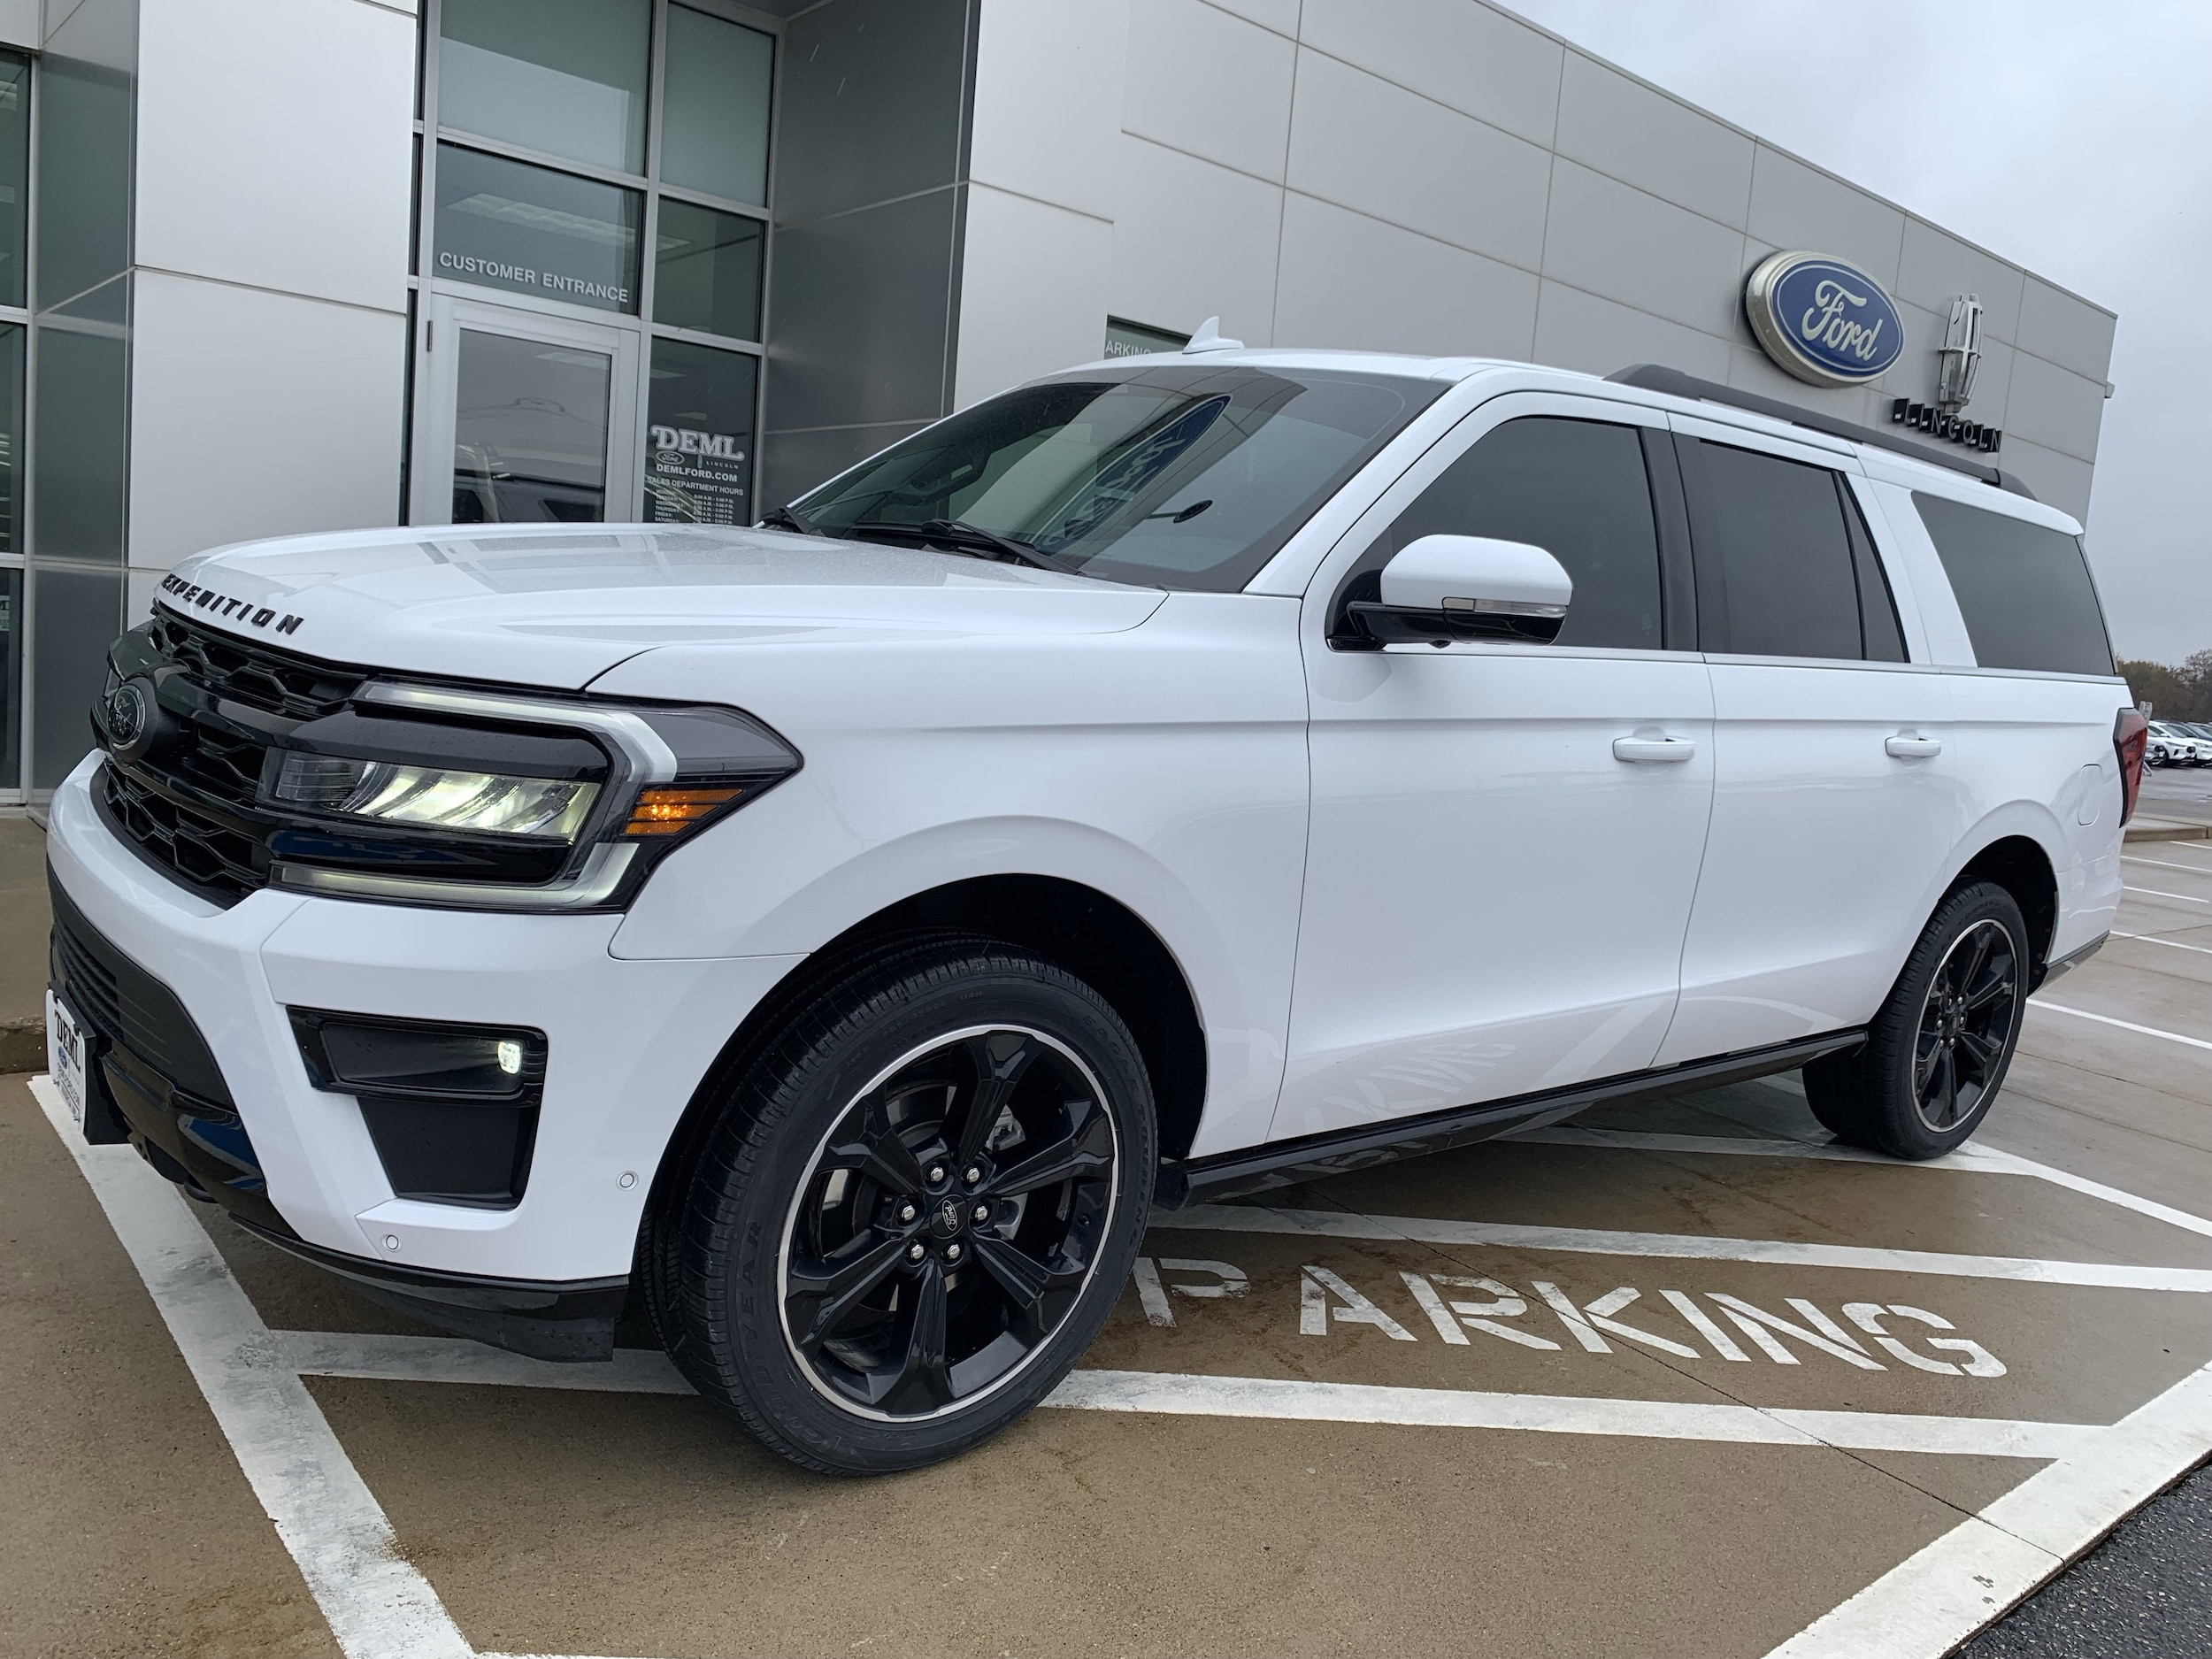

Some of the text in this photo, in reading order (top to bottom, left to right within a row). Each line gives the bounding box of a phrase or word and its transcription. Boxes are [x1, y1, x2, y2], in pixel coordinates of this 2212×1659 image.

[440, 252, 628, 303] CUSTOMER ENTRANCE
[1801, 280, 1883, 361] Ford
[650, 425, 745, 461] DEML
[1893, 398, 2002, 453] LINCOLN
[647, 476, 744, 496] SALES DEPARTMENT HOURS
[656, 464, 738, 482] DEMLFORD.COM
[706, 460, 739, 470] LINCOLN
[161, 573, 304, 635] EXPEDITION
[55, 1009, 81, 1074] DEML
[1133, 1257, 2008, 1378] PARKING
